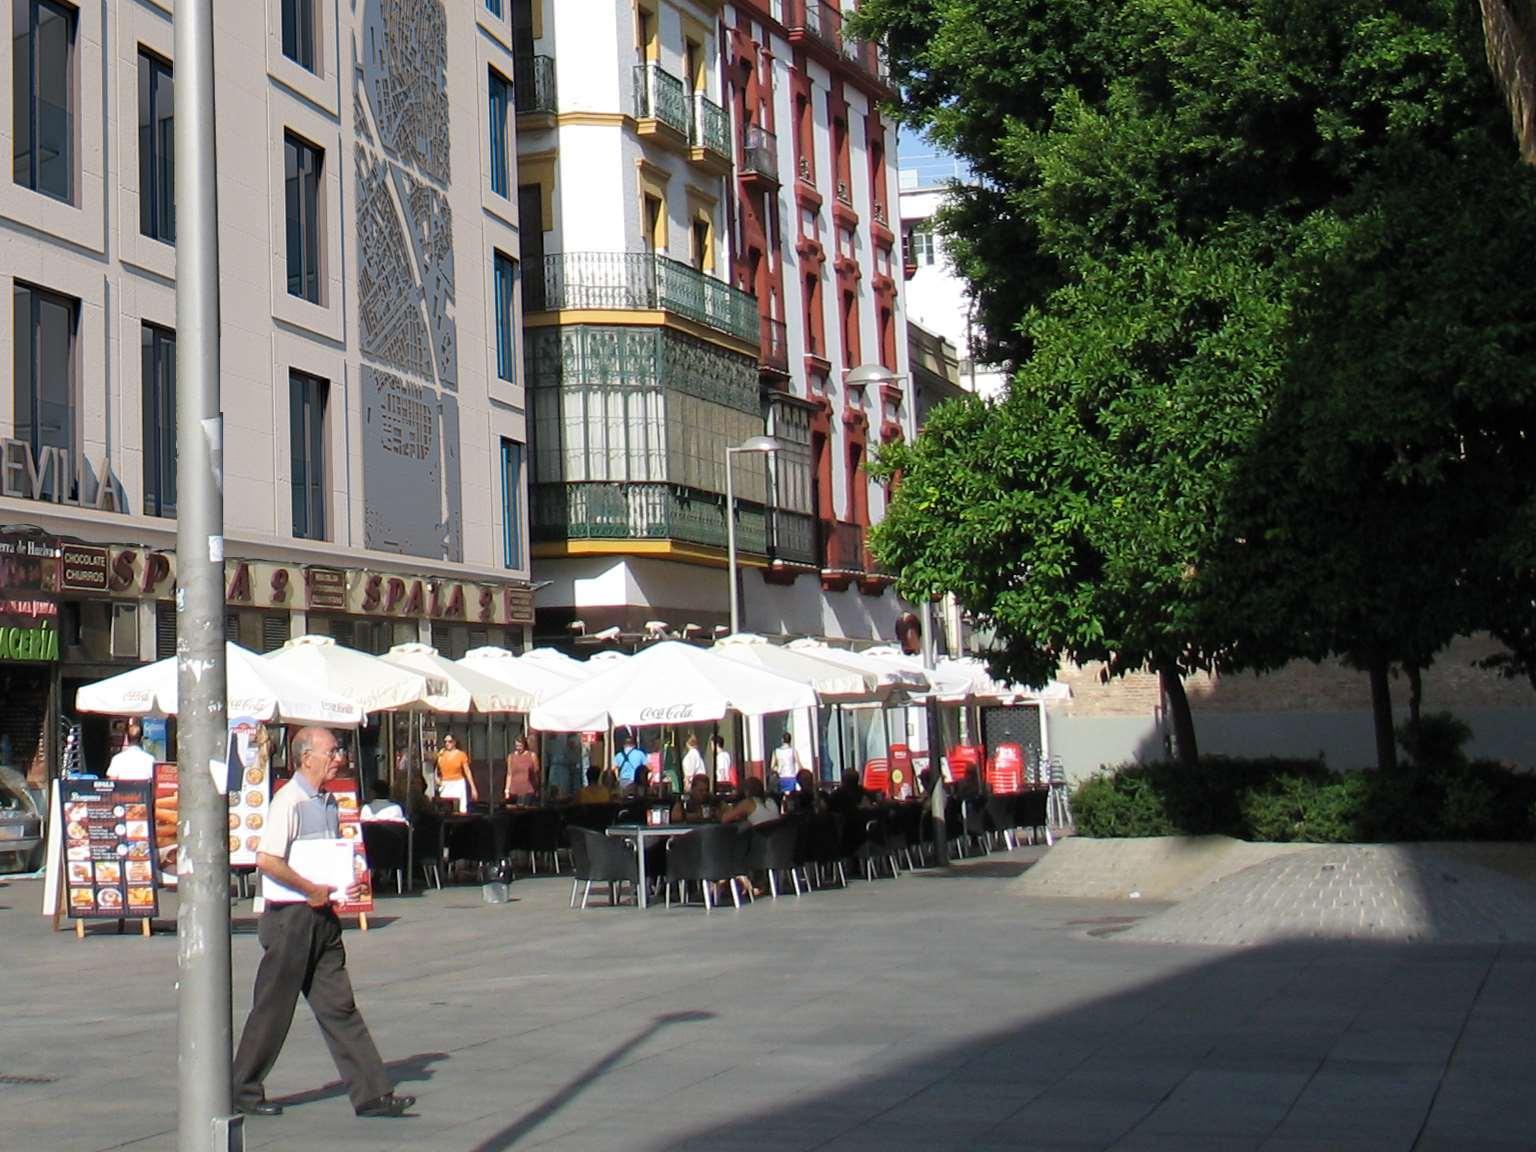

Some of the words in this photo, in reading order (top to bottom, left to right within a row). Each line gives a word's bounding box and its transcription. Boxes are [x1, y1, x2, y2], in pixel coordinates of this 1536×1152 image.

[64, 552, 106, 567] CHOCOLATE
[66, 571, 105, 583] CHURROS
[362, 575, 465, 617] SPALA
